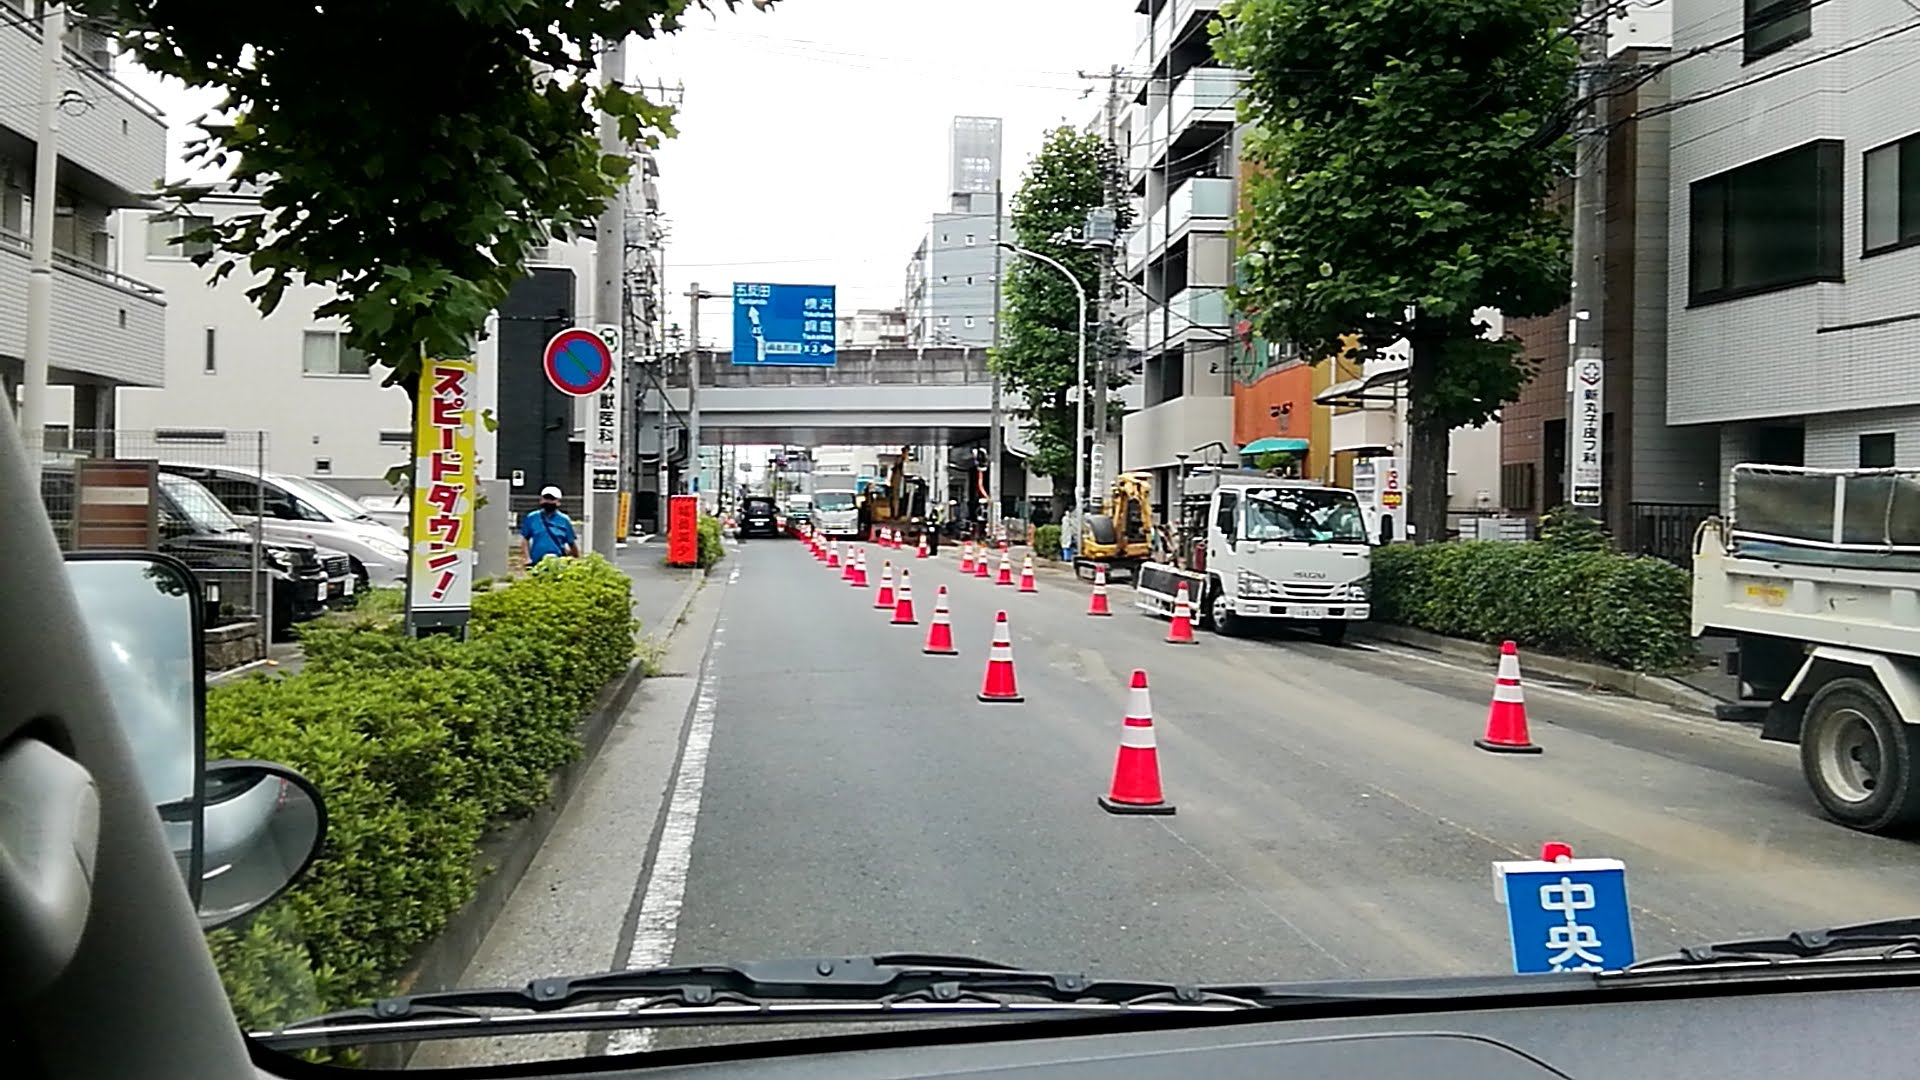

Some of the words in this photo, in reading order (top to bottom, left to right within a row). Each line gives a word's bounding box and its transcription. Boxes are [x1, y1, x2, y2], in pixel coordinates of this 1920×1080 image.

[1583, 389, 1600, 465] 新丸子皮フ科
[1539, 876, 1604, 973] 中央
